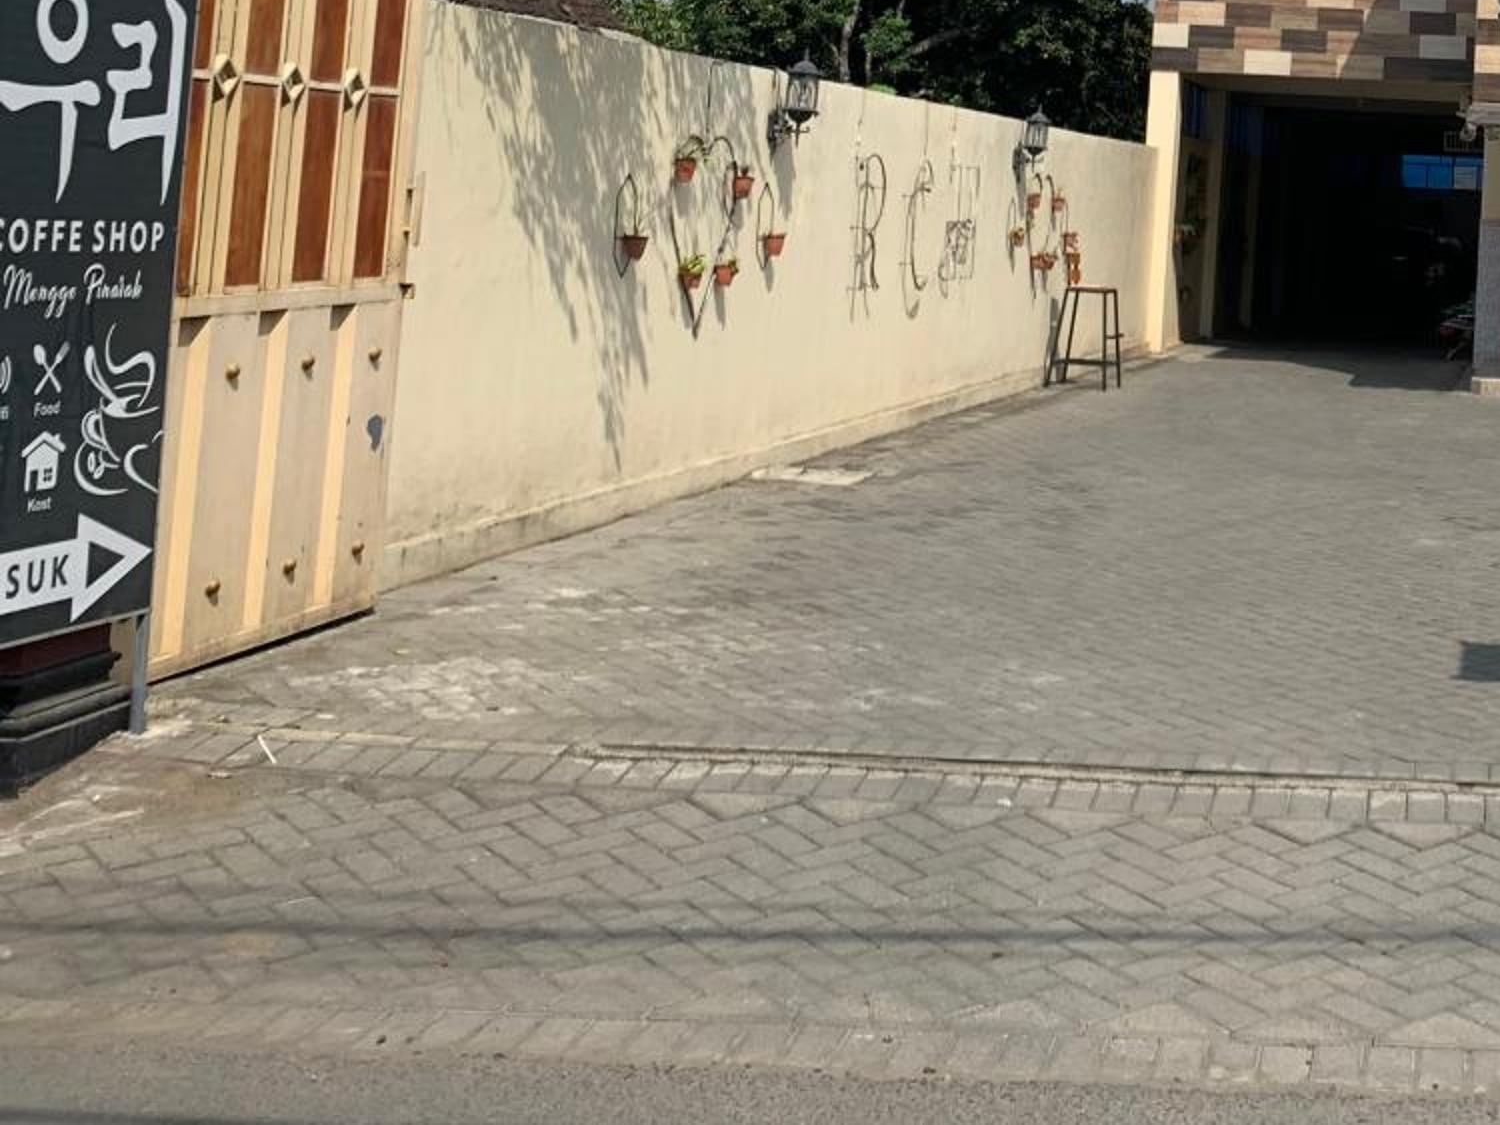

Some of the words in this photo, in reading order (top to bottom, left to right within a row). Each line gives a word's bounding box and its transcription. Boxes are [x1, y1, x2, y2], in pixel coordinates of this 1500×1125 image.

[92, 220, 164, 253] SHOP
[34, 400, 61, 417] Food
[27, 496, 52, 513] Kost
[5, 554, 69, 600] SUK
